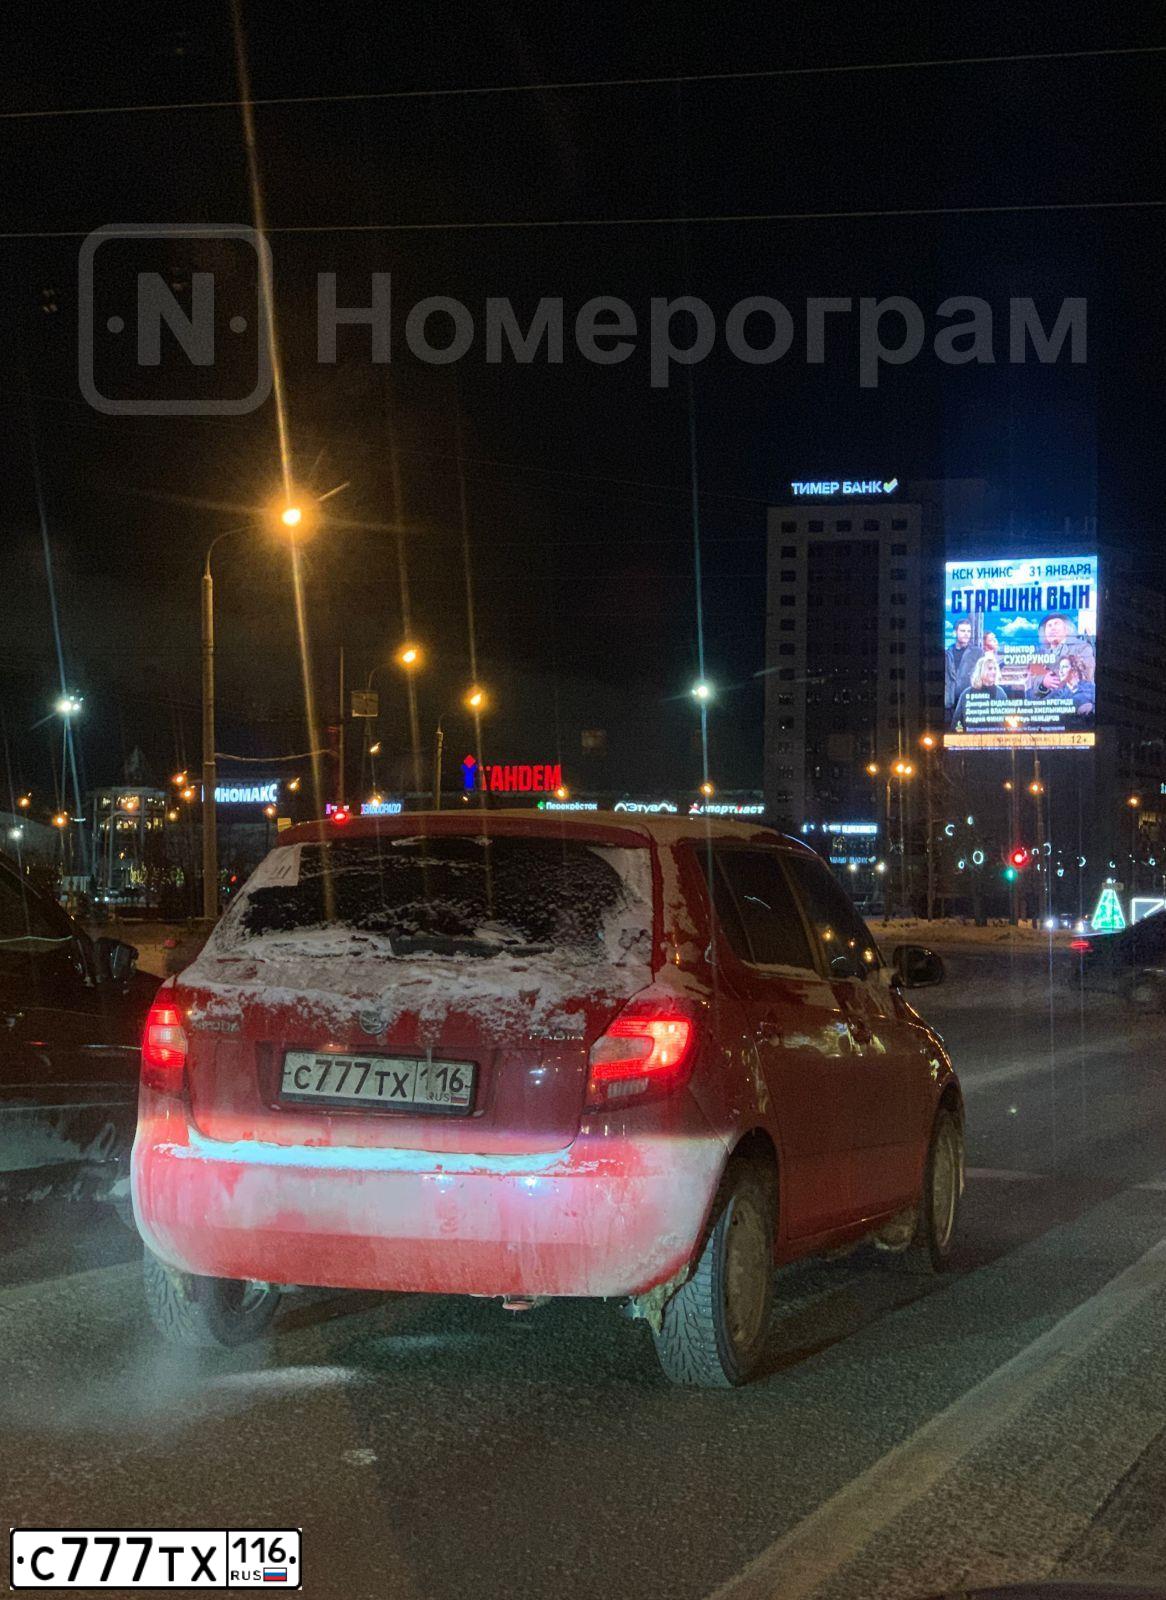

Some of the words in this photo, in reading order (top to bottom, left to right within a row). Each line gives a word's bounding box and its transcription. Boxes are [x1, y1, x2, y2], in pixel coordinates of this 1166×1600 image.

[791, 481, 840, 495] ТИМЕР
[842, 480, 882, 494] БАНК
[952, 568, 973, 580] КСК
[977, 566, 1013, 579] УНИКС
[1029, 566, 1041, 577] 31
[1045, 563, 1091, 576] ЯНВАРЯ
[951, 581, 1043, 614] СТАРШИЙ
[1003, 653, 1056, 665] СУХОРУКОВ
[293, 1058, 410, 1099] С777ТХ
